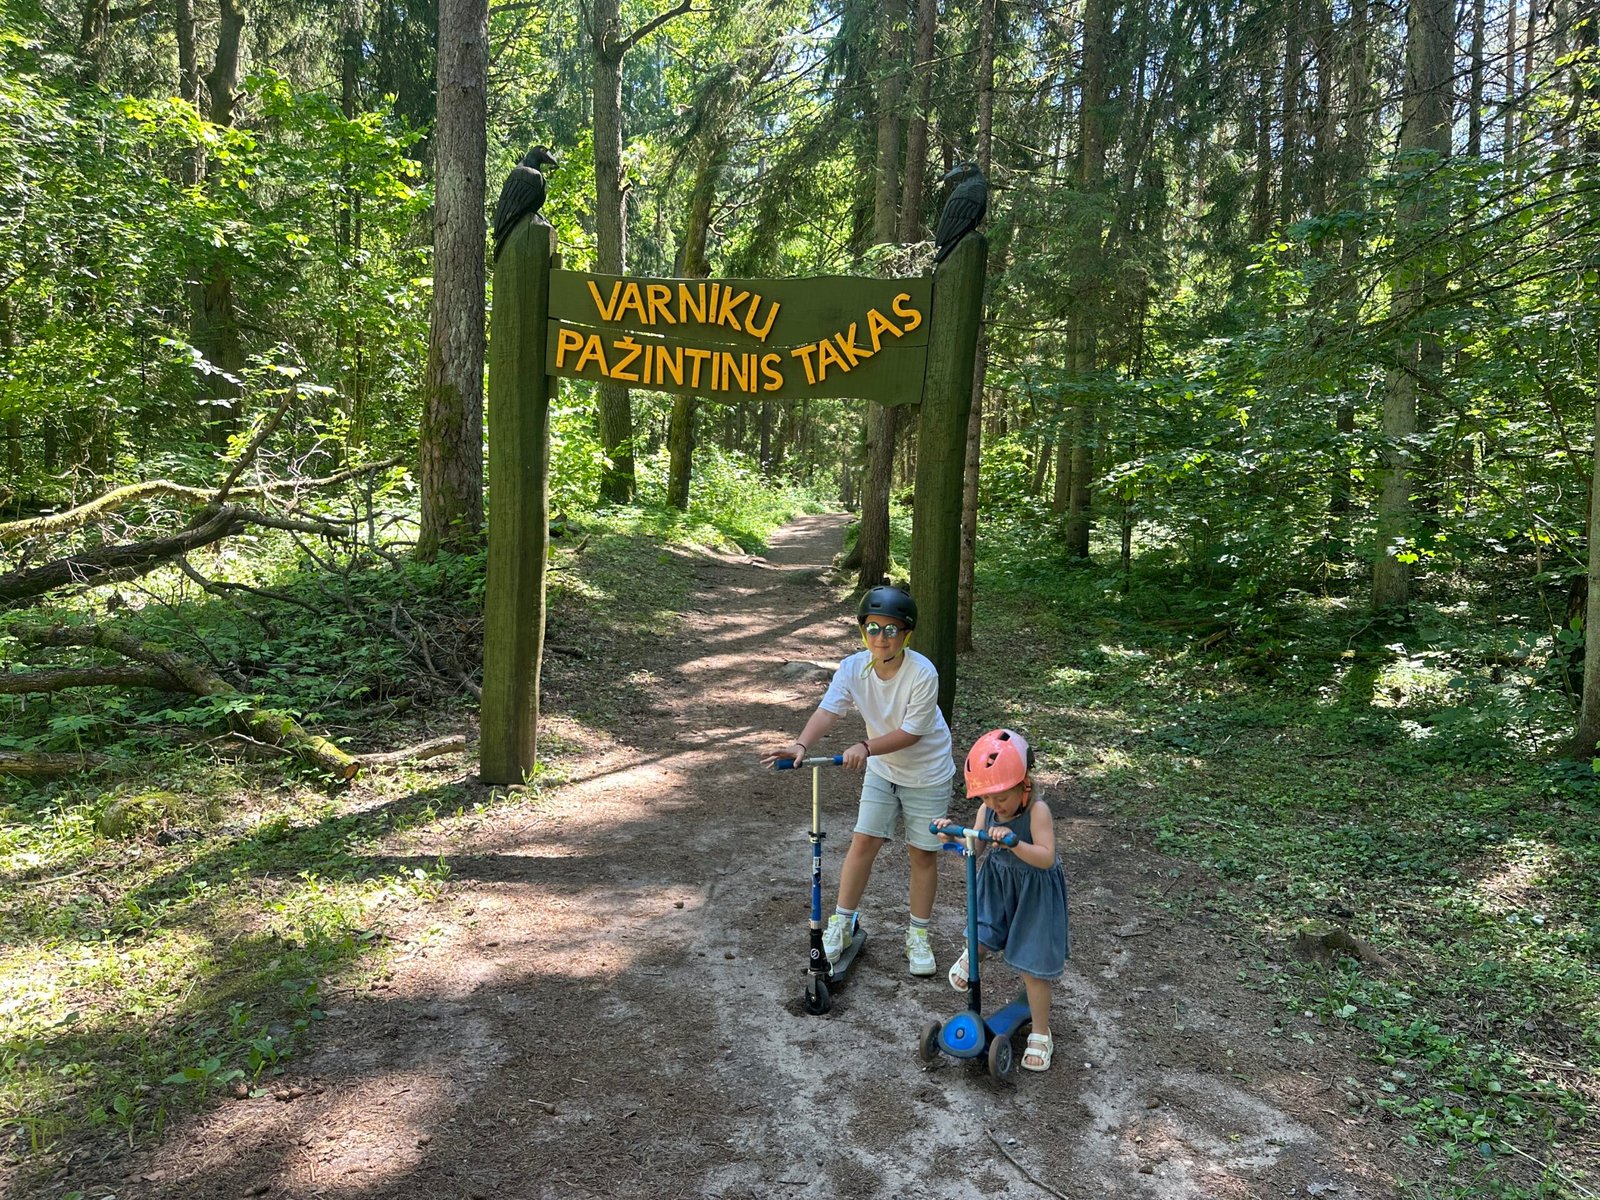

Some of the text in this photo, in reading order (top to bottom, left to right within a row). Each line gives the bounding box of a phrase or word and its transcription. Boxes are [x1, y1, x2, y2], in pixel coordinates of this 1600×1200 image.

[556, 293, 922, 393] PAŽINTINIS TAKAS
[587, 281, 780, 341] VARNIKŲ
